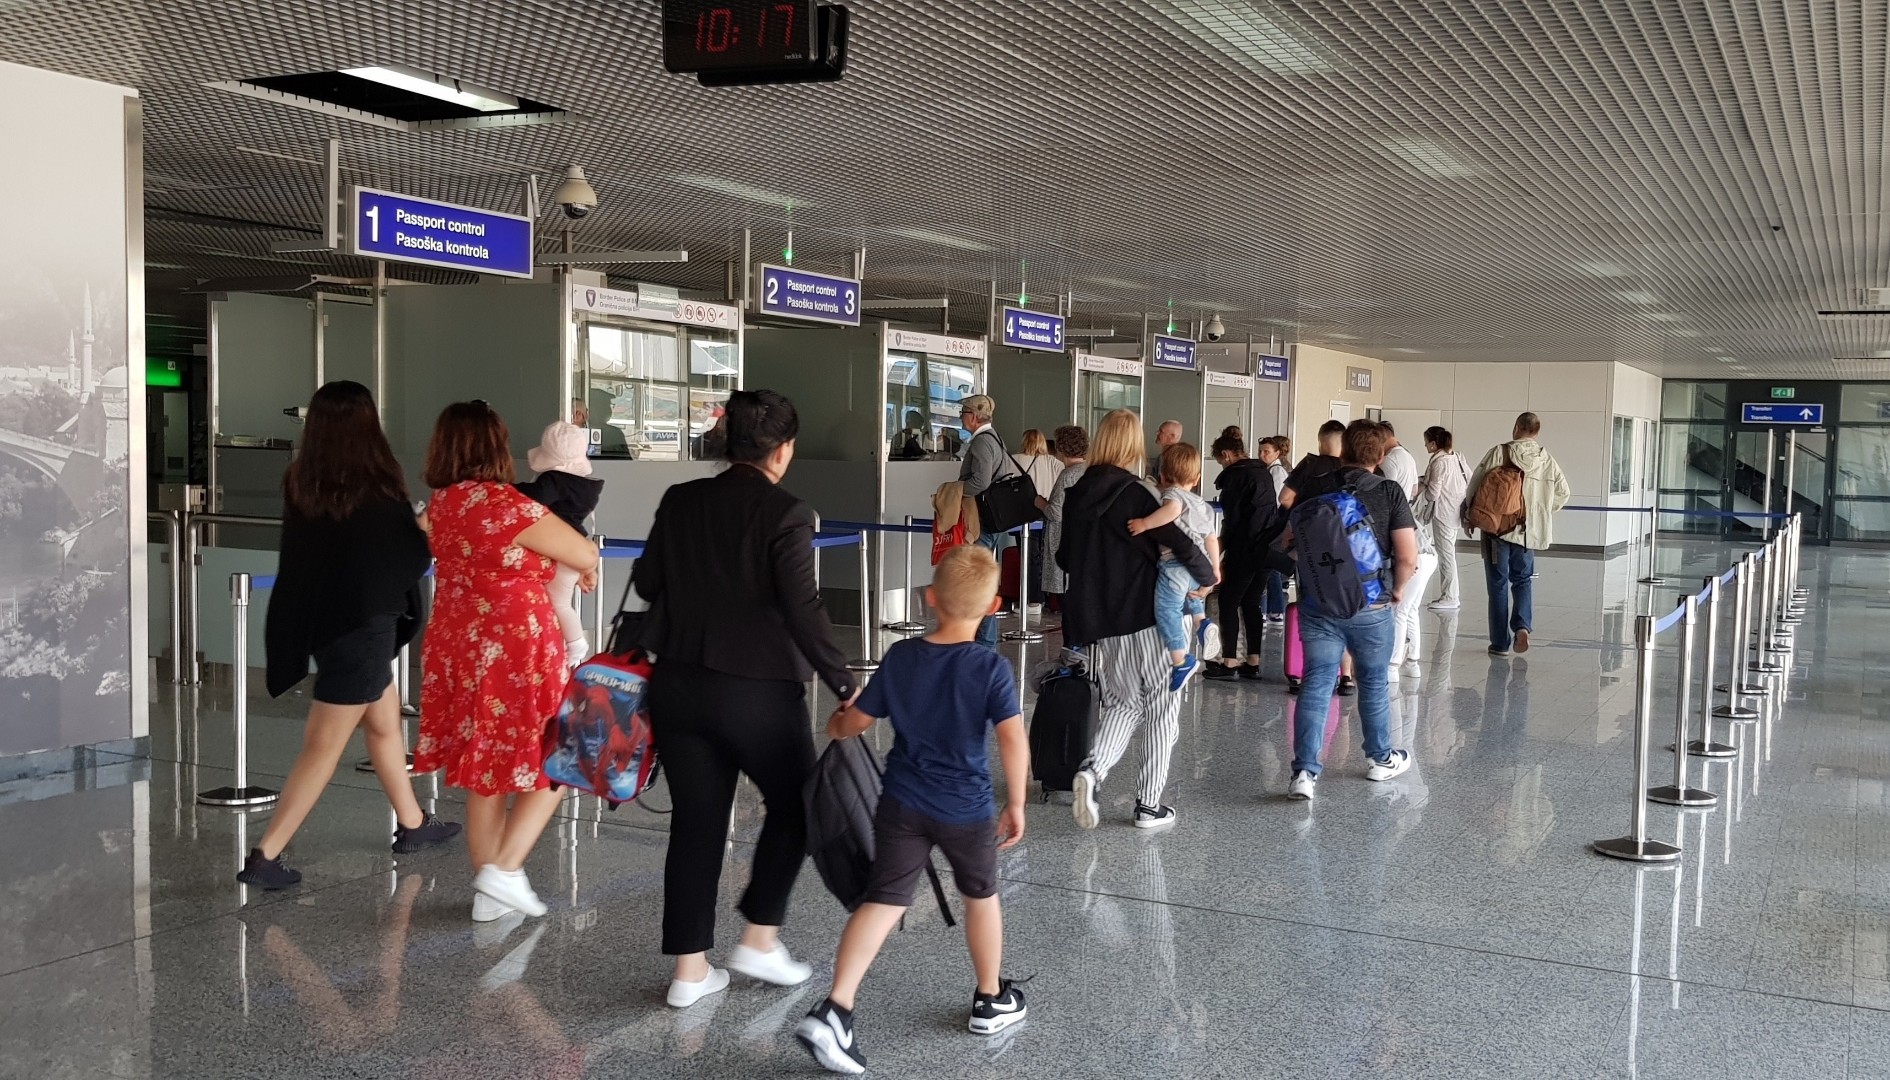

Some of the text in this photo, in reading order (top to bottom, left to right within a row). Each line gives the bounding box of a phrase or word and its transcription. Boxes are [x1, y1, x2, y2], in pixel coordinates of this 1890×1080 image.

[695, 4, 795, 53] 10:17
[366, 206, 379, 243] 1
[396, 209, 485, 236] Passport control
[396, 232, 489, 259] Pasoška kontrola
[766, 277, 779, 305] 2
[787, 280, 837, 297] Passport control
[787, 297, 839, 313] Pasoška kontrola
[844, 289, 855, 315] 3
[1006, 316, 1014, 338] 4
[1054, 324, 1061, 345] 5
[1156, 342, 1161, 360] 6
[1189, 347, 1194, 364] 7
[1258, 359, 1263, 376] 8
